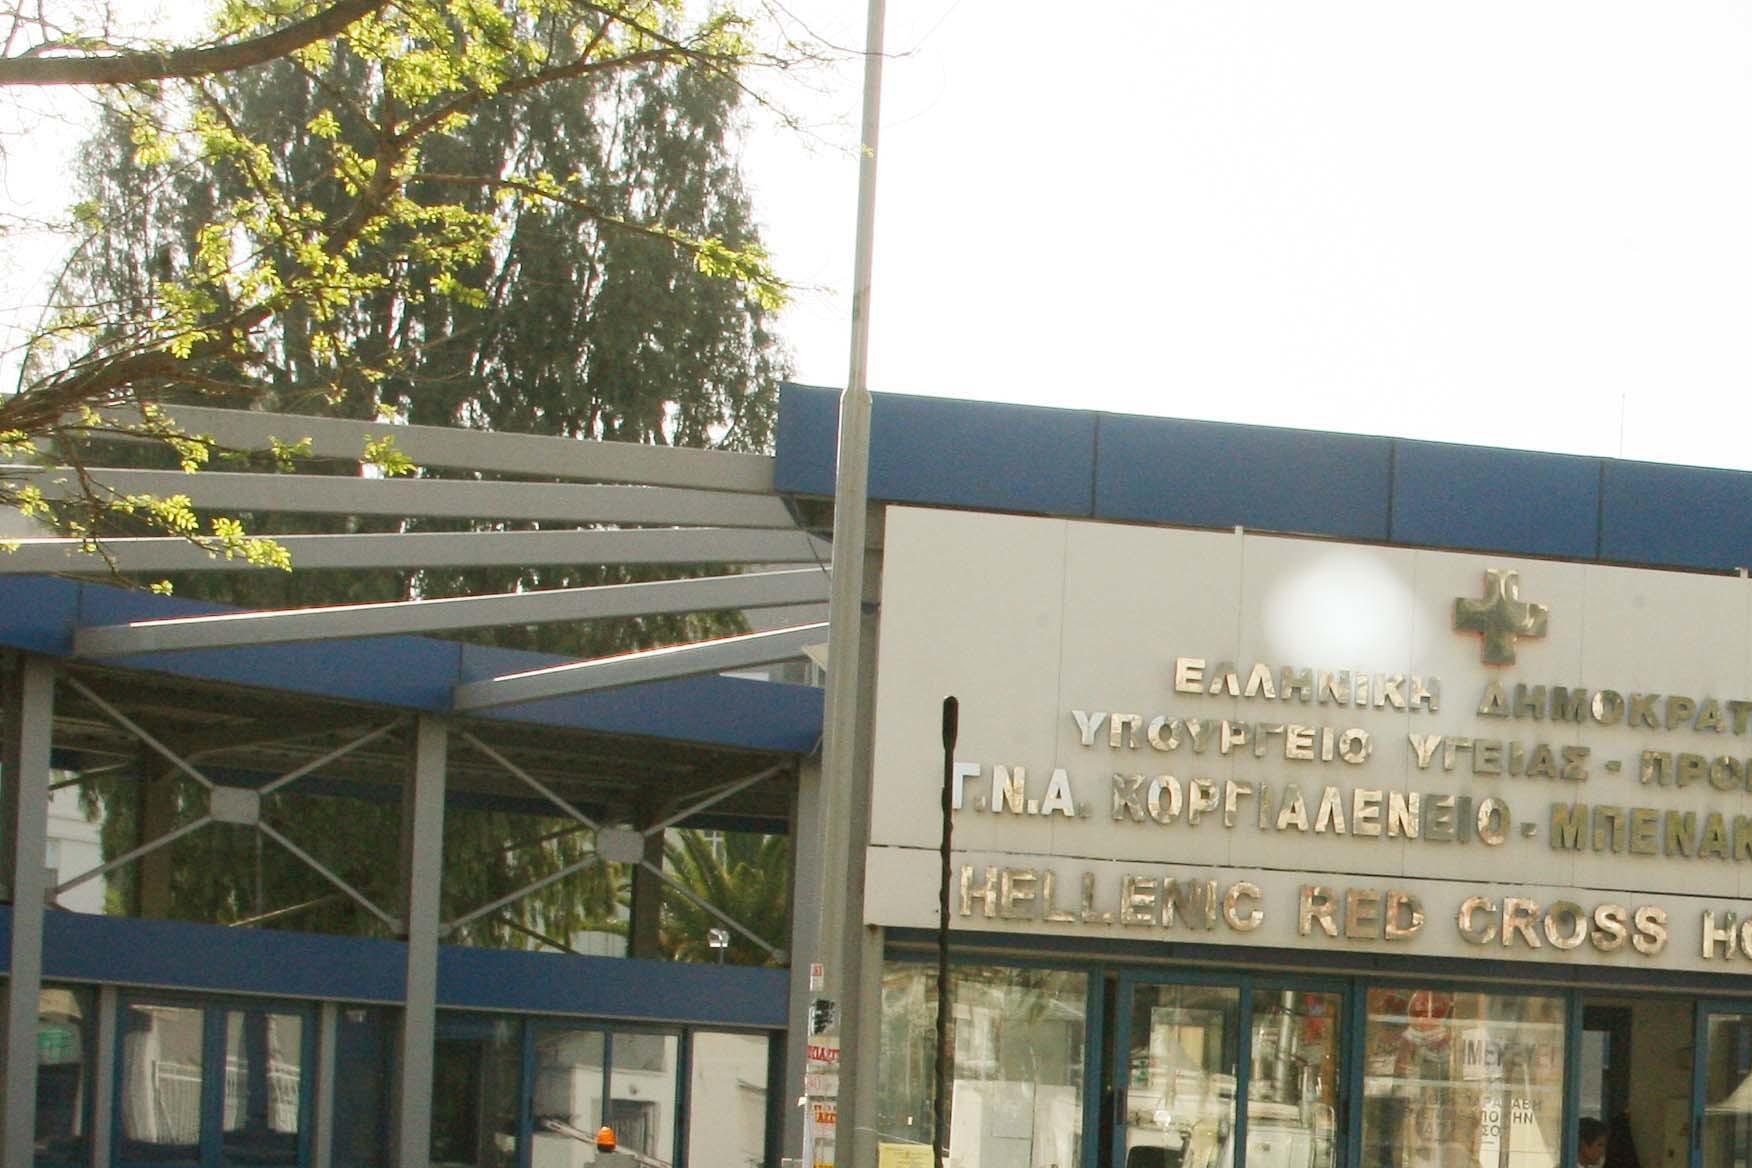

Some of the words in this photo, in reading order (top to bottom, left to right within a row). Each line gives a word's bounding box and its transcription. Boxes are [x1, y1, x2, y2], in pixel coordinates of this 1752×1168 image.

[1174, 656, 1441, 713] ΕΛΛΗΝΙΚΗ
[1072, 709, 1372, 765] ΥΠΟΥΡΓΕΙΟ
[1409, 733, 1591, 783] ΥΓΕΙΑΣ
[1111, 772, 1511, 848] ΚΟΡΓΙΑΛΕΝΕΙΟ
[959, 865, 1265, 933] HELLENIC
[1299, 883, 1426, 942] RED
[1457, 896, 1668, 957] CROSS
